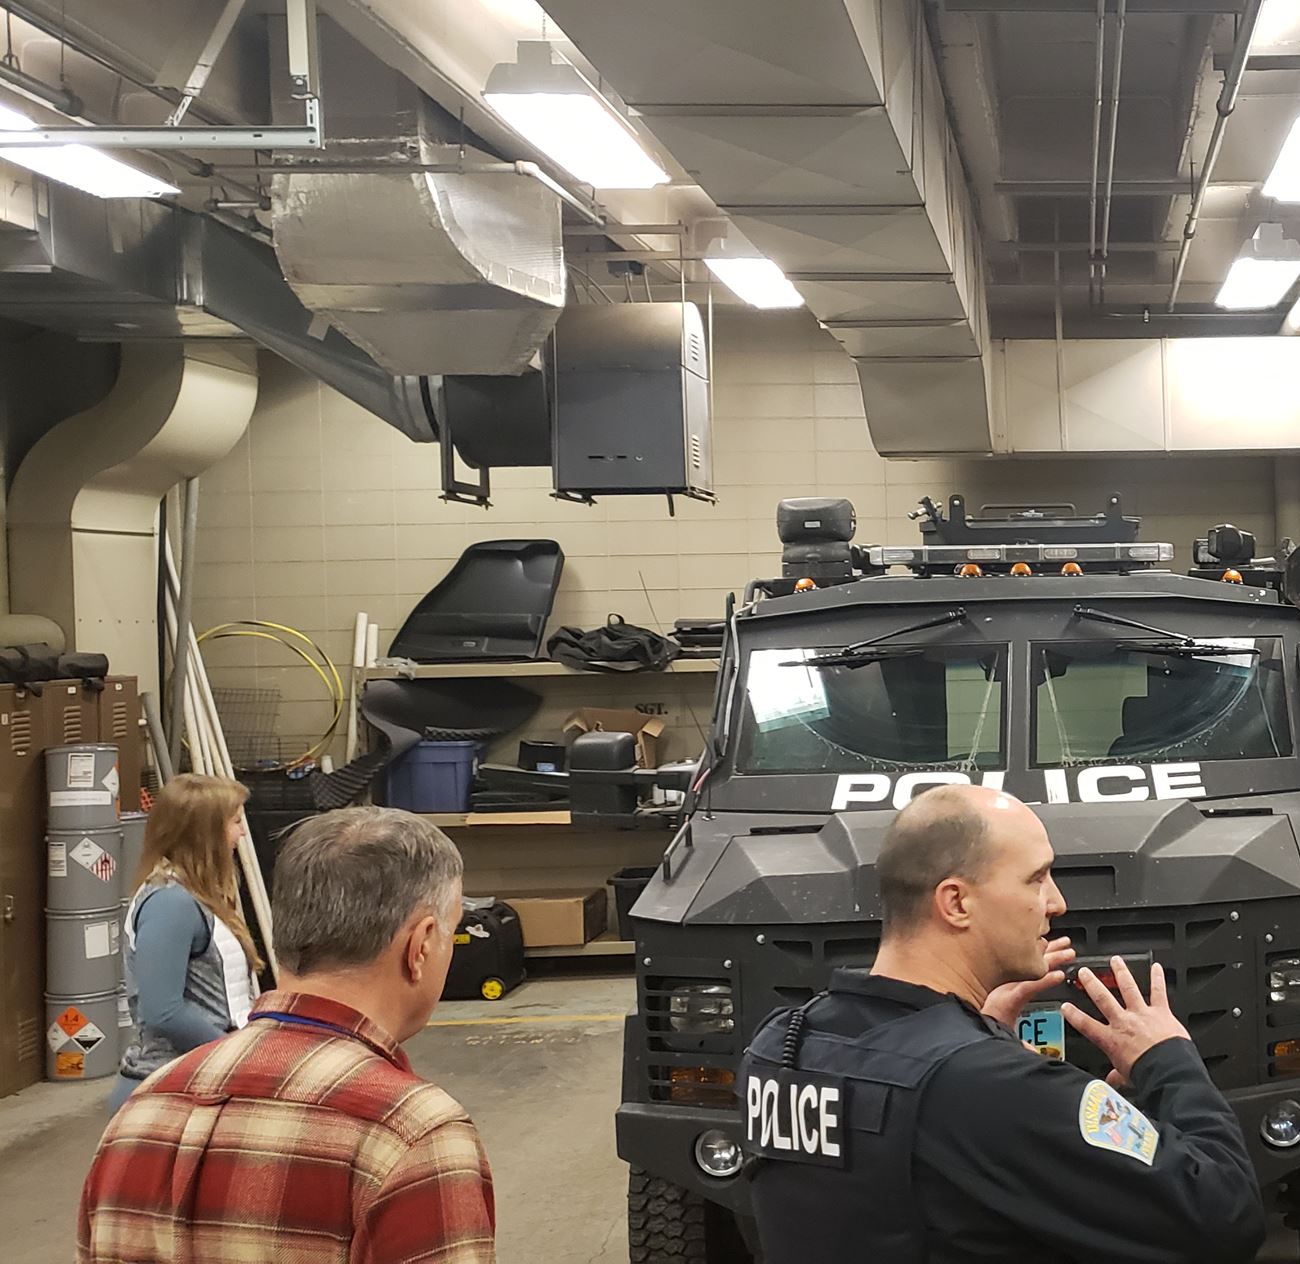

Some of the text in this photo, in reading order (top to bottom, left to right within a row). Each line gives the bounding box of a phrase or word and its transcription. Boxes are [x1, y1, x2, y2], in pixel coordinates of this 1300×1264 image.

[635, 703, 668, 715] SGT.
[831, 762, 1207, 810] POLICE
[64, 1014, 79, 1022] 1.4
[747, 1075, 840, 1157] POLICE
